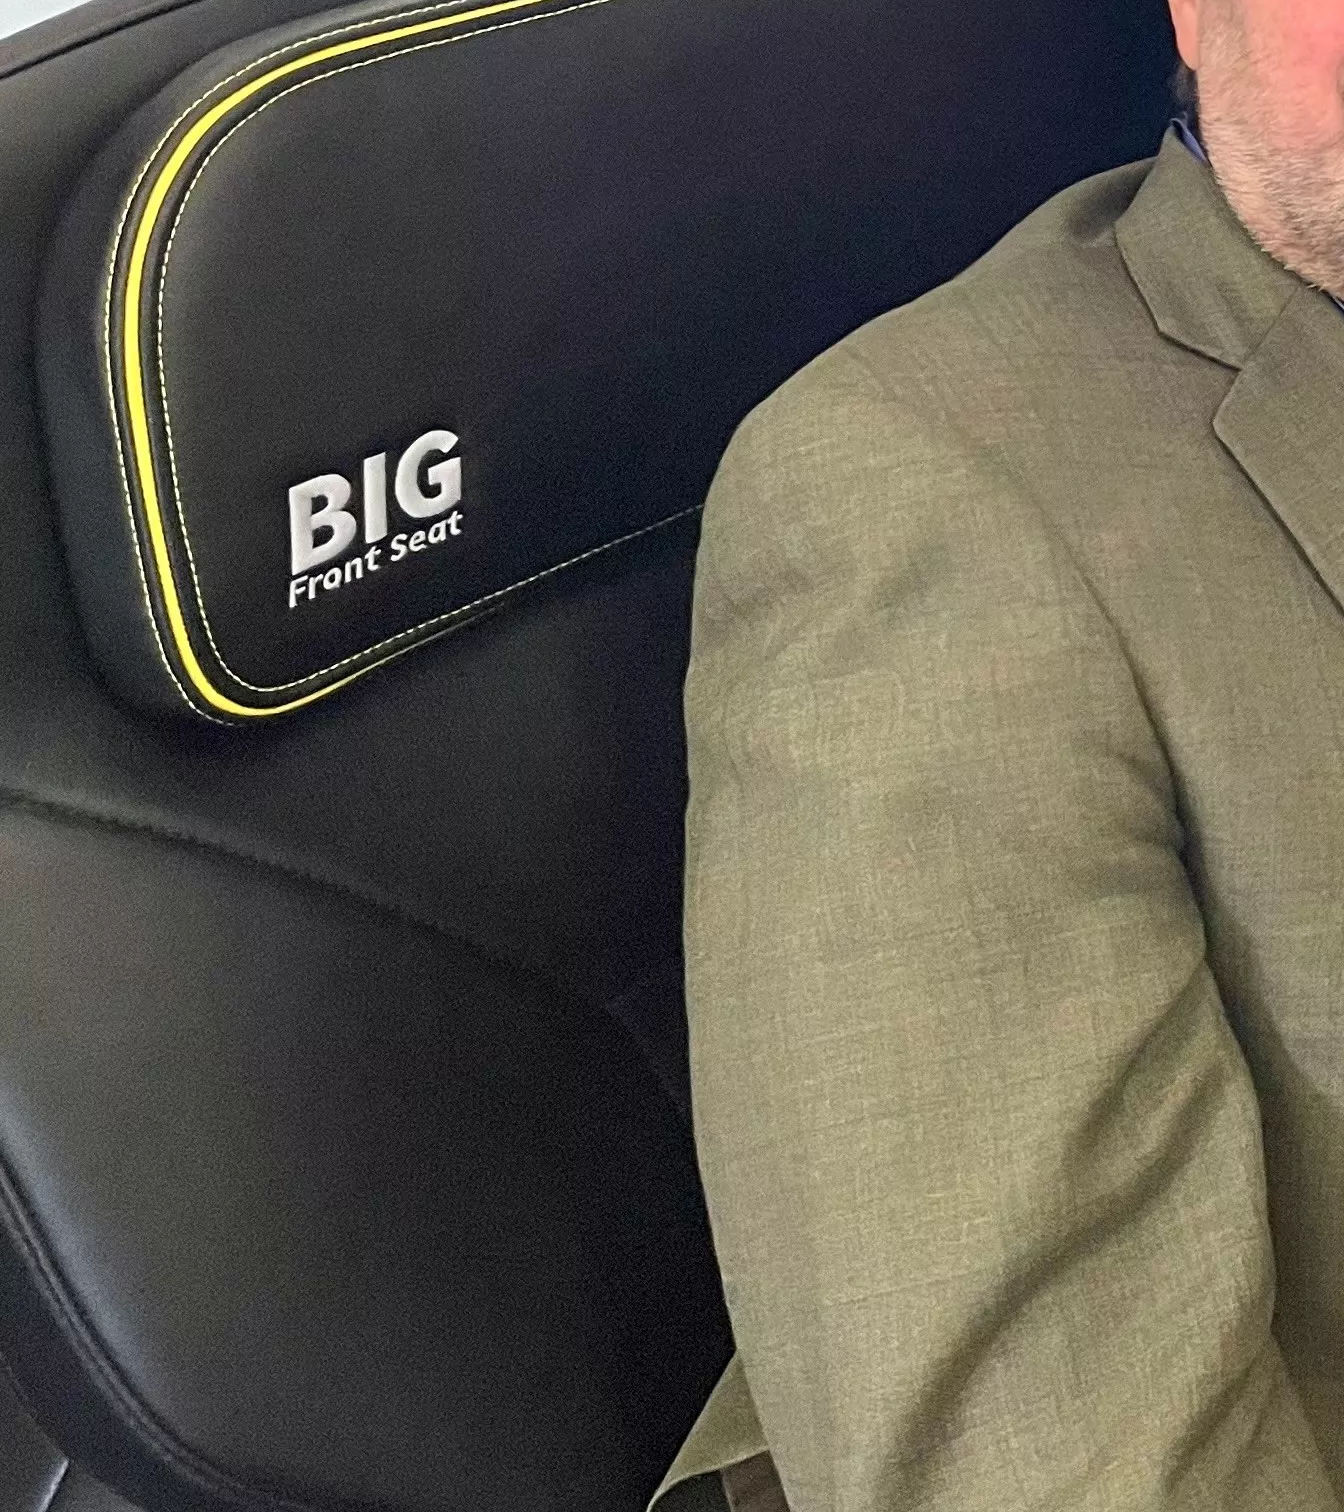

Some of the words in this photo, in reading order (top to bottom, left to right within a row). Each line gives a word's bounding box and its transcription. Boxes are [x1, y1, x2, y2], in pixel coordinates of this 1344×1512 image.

[289, 430, 461, 575] BIG
[289, 546, 382, 608] Front
[390, 510, 463, 561] Seat
